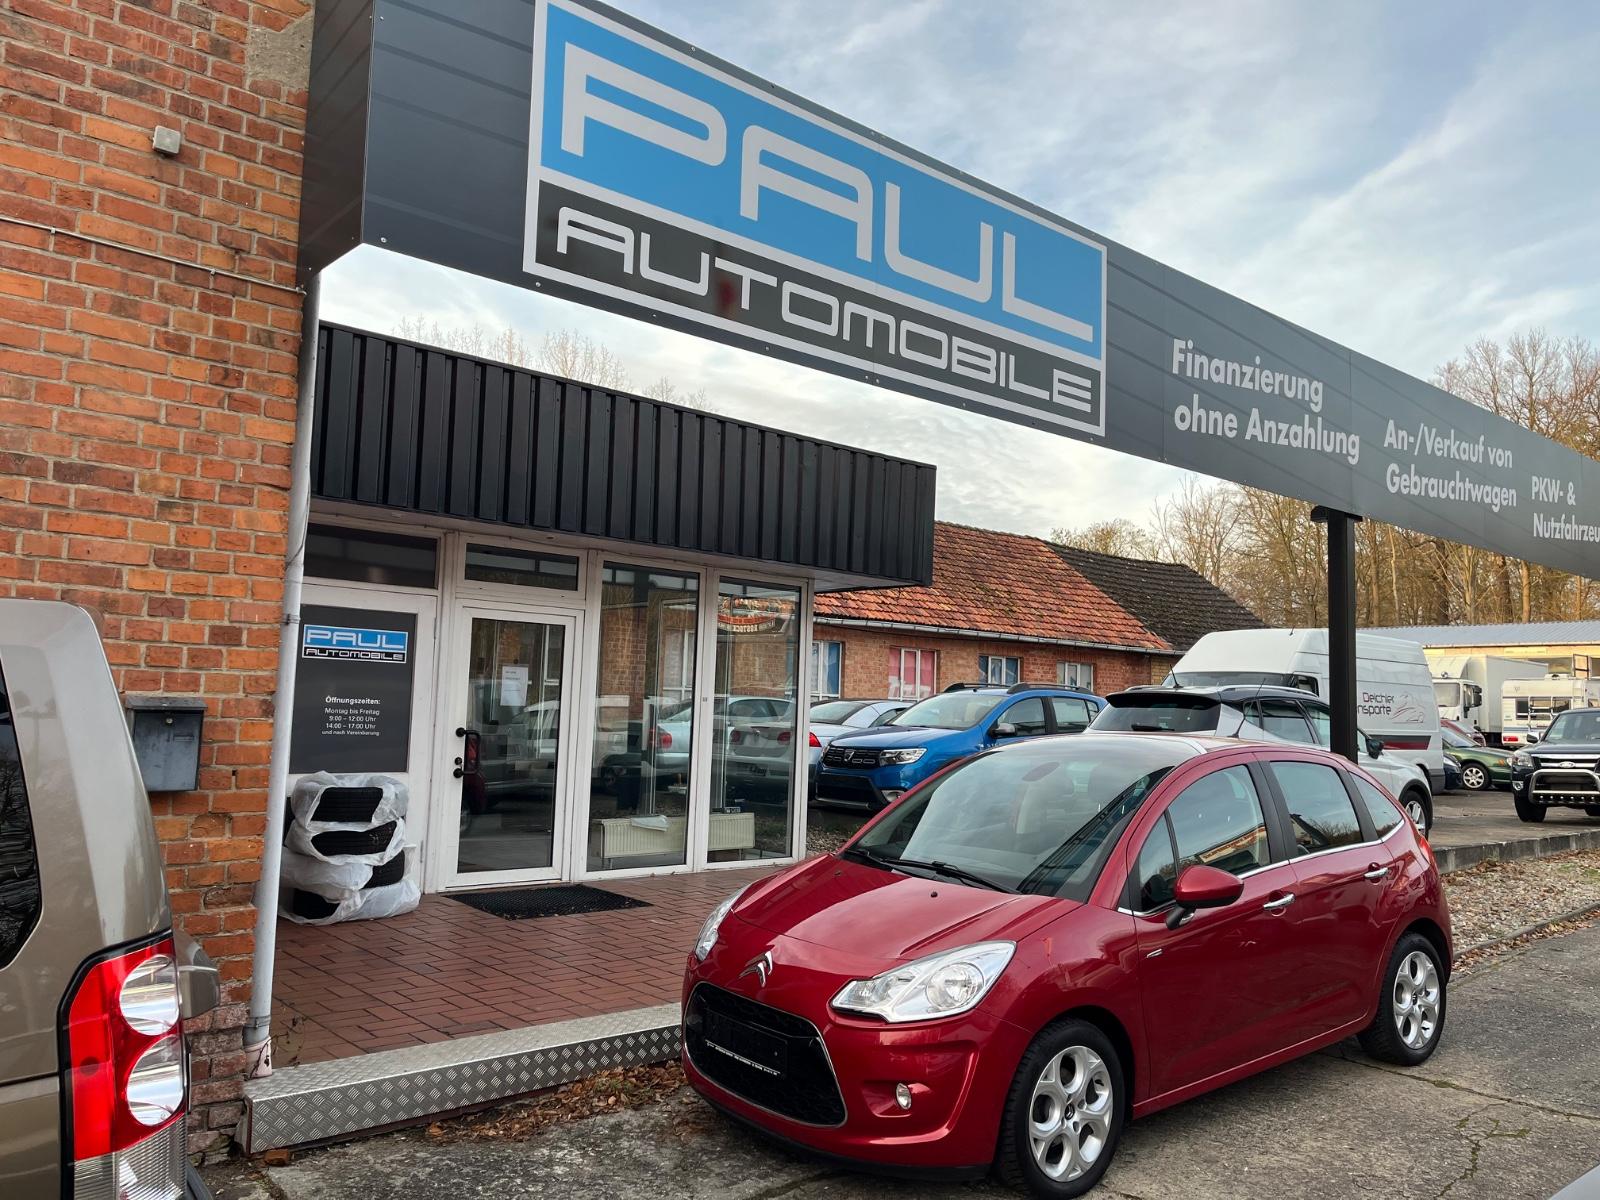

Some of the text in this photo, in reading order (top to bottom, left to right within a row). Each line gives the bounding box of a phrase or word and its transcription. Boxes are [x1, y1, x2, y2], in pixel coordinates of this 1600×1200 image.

[561, 41, 1093, 343] PAUL
[557, 206, 1092, 413] AUTOMOBILE
[1172, 338, 1324, 413] Finanzierung
[1174, 394, 1360, 465] ohne Anzahlung
[1383, 419, 1513, 469] An-/Verkauf von
[1386, 463, 1517, 513] Gebrauchtwagen
[1531, 475, 1577, 506] PKW- &
[305, 648, 403, 661] AUTOMOBILE
[306, 629, 404, 649] PAUL
[324, 707, 349, 715] Montag
[359, 708, 380, 716] Freitag
[325, 695, 381, 705] Öffnungszeiten:
[1357, 704, 1392, 717] nsporte
